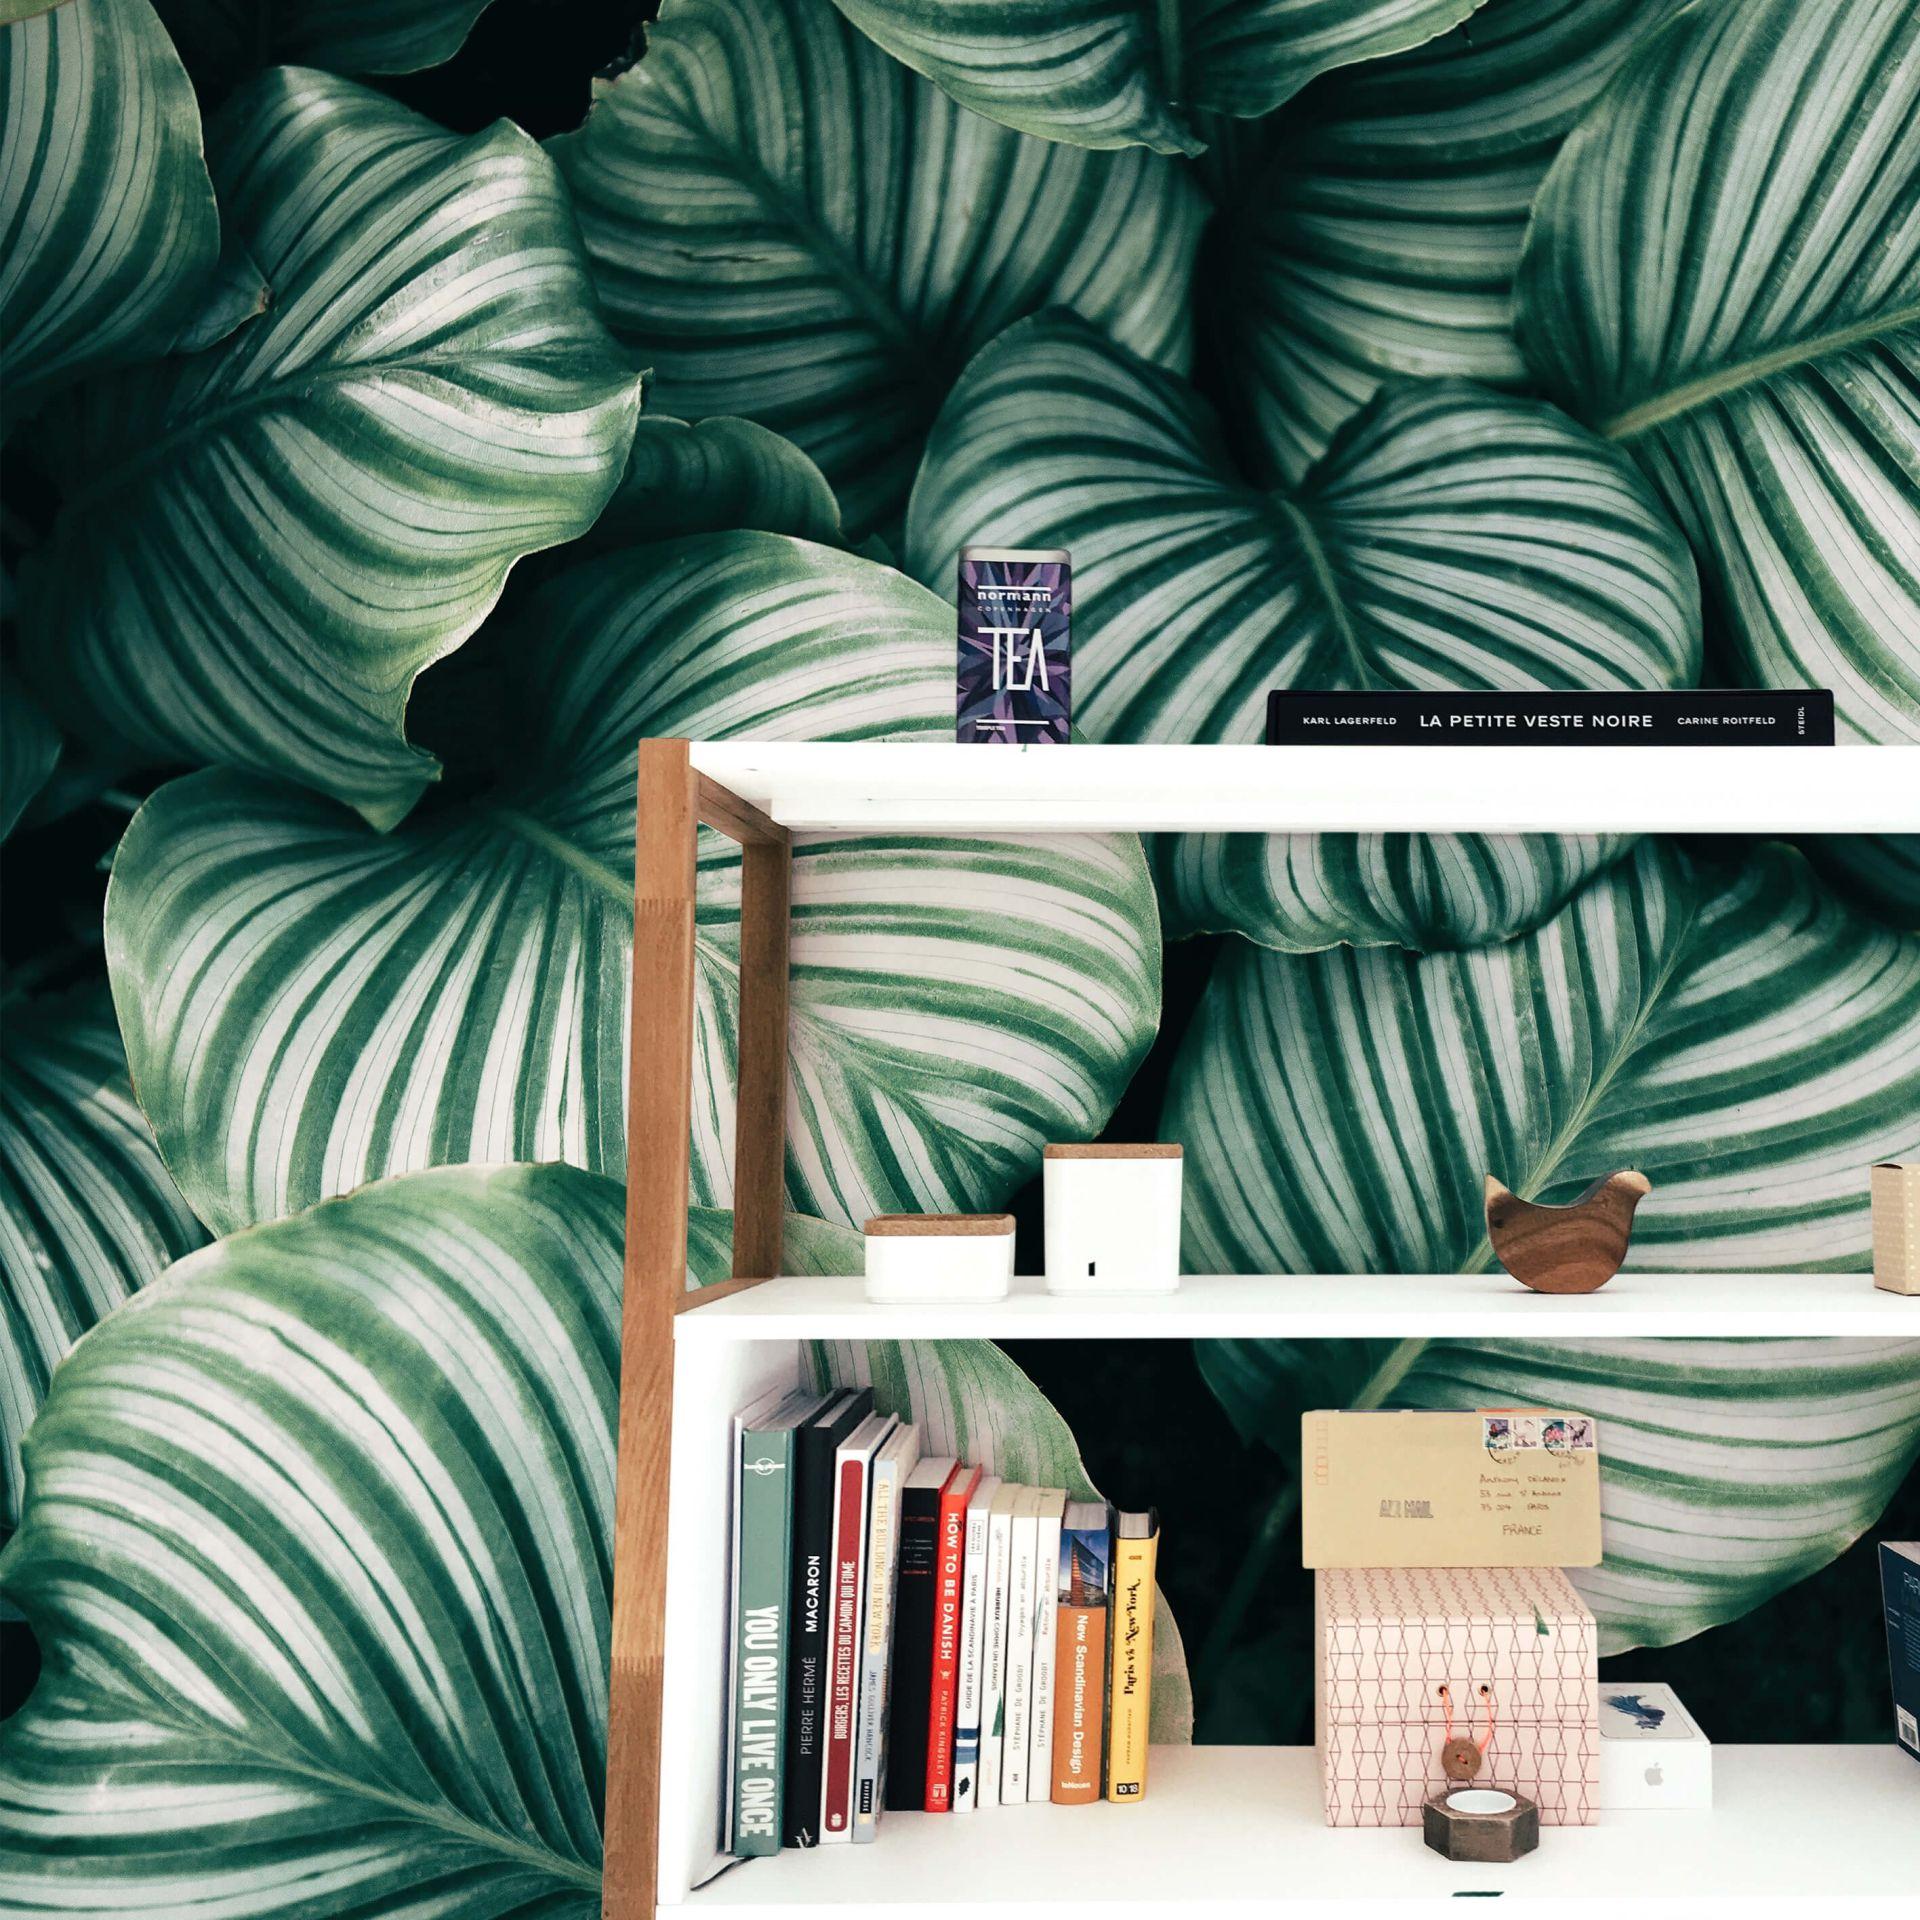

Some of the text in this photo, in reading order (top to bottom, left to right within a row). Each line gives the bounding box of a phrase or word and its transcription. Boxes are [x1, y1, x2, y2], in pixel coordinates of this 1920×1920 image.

[978, 591, 1051, 601] normann
[978, 627, 1050, 691] TEA
[1303, 717, 1397, 725] KARL LAGERFELD
[1420, 715, 1653, 728] LA PETITE VESTE NOIRE
[1677, 717, 1776, 725] CARINE ROITFELD
[1503, 1524, 1542, 1536] FRANCE
[842, 1561, 856, 1583] FUME
[870, 1484, 889, 1649] ALL THE BUILDINGS IN NEW YORK
[805, 1555, 820, 1632] MACARON
[841, 1585, 855, 1598] QUI
[941, 1512, 959, 1661] HOW TO BE DANISH
[970, 1575, 978, 1597] PARIS
[1126, 1579, 1141, 1616] York
[839, 1600, 853, 1633] CAMION
[967, 1606, 977, 1658] SCANDINAVIE
[1077, 1615, 1089, 1641] New
[1125, 1616, 1140, 1646] New
[837, 1647, 851, 1685] RECETTES
[967, 1660, 974, 1671] LA
[992, 1650, 999, 1662] UN
[966, 1673, 973, 1684] DE
[991, 1663, 999, 1691] DANOIS
[1073, 1645, 1088, 1727] Scandinavian
[1124, 1664, 1138, 1695] Paris
[799, 1657, 816, 1755] PIERRE HERMÉ
[836, 1686, 849, 1701] LES
[965, 1686, 973, 1709] GUIDE
[740, 1605, 779, 1837] YOU ONLY LIVE ONCE
[834, 1702, 850, 1740] BURGERS,
[936, 1690, 948, 1776] PATRICK KINGSLEY
[864, 1728, 874, 1763] HANCOCK
[1069, 1731, 1084, 1774] Design
[862, 1781, 870, 1813] UNIVERSE
